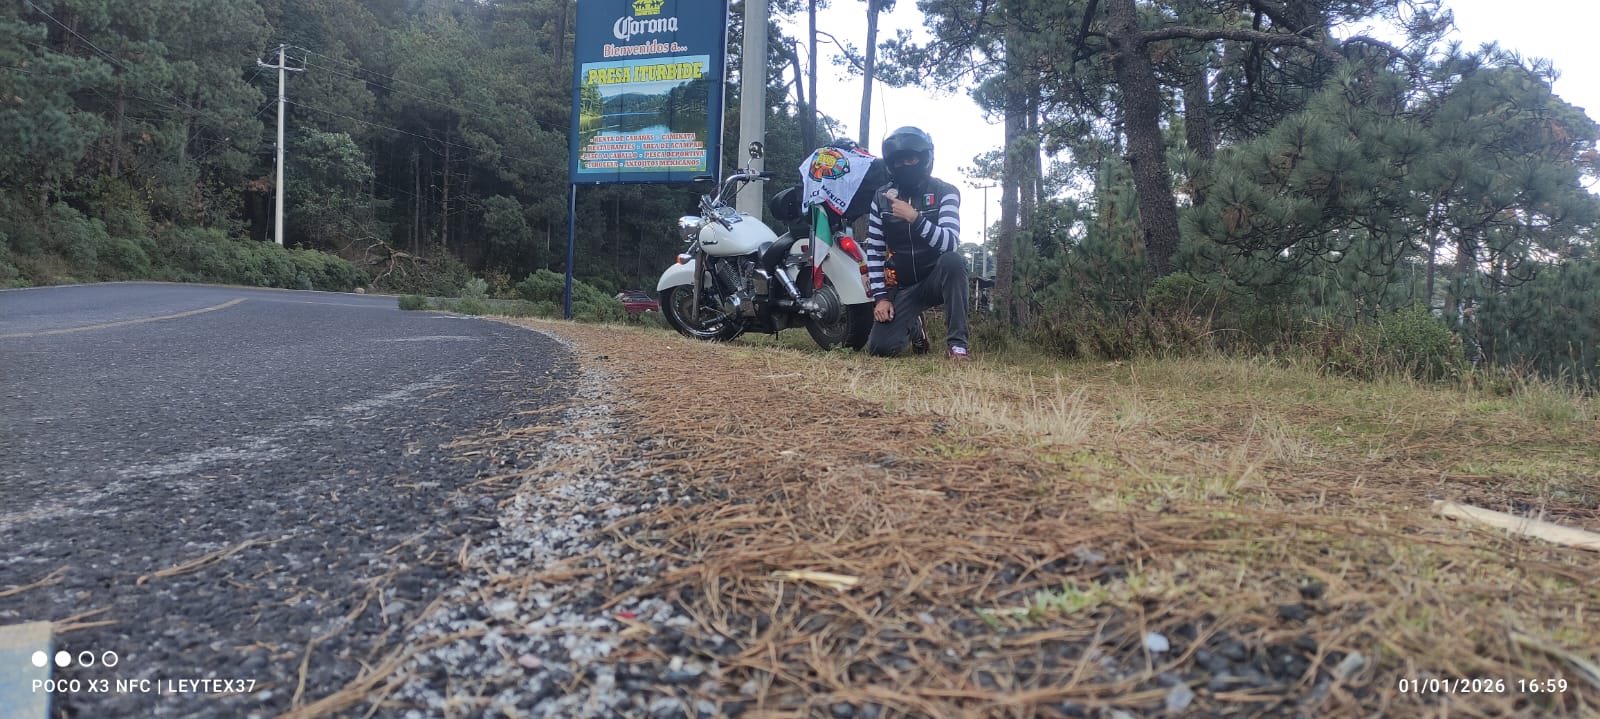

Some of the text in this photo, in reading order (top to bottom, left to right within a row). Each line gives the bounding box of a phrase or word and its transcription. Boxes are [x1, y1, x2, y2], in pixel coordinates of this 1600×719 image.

[613, 15, 678, 41] Corona
[604, 39, 669, 58] Bienvenidos
[588, 62, 702, 85] PRESA ITURBIDE
[587, 143, 635, 151] RESTAURANTES
[593, 135, 613, 143] RENTA
[661, 132, 696, 140] CAMINATA
[625, 160, 659, 168] ANTOJITOS
[821, 185, 847, 208] MÉXICO
